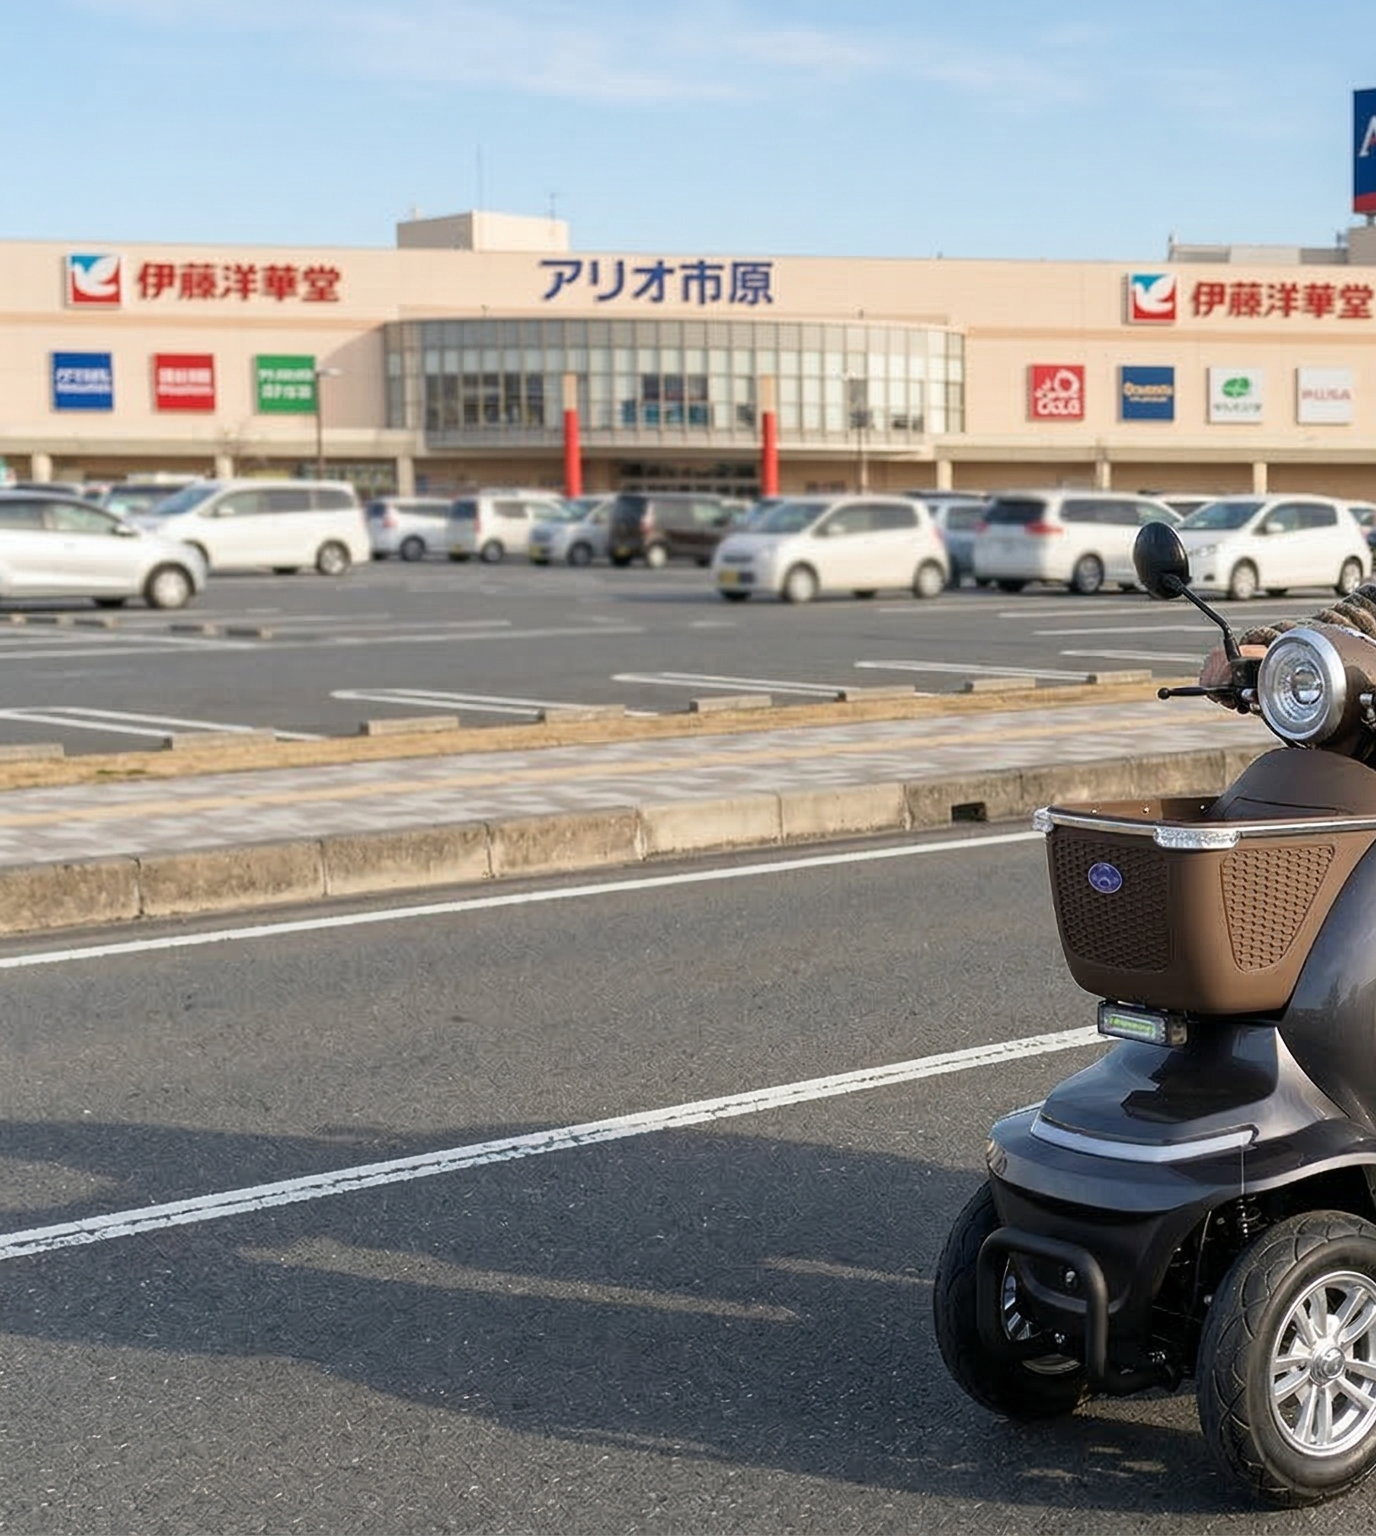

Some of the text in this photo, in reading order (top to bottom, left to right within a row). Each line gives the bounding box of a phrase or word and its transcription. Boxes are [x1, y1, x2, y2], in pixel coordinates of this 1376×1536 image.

[138, 262, 341, 302] 伊藤洋華堂
[539, 259, 774, 305] アリオ市原
[1190, 281, 1374, 319] 伊藤洋華堂
